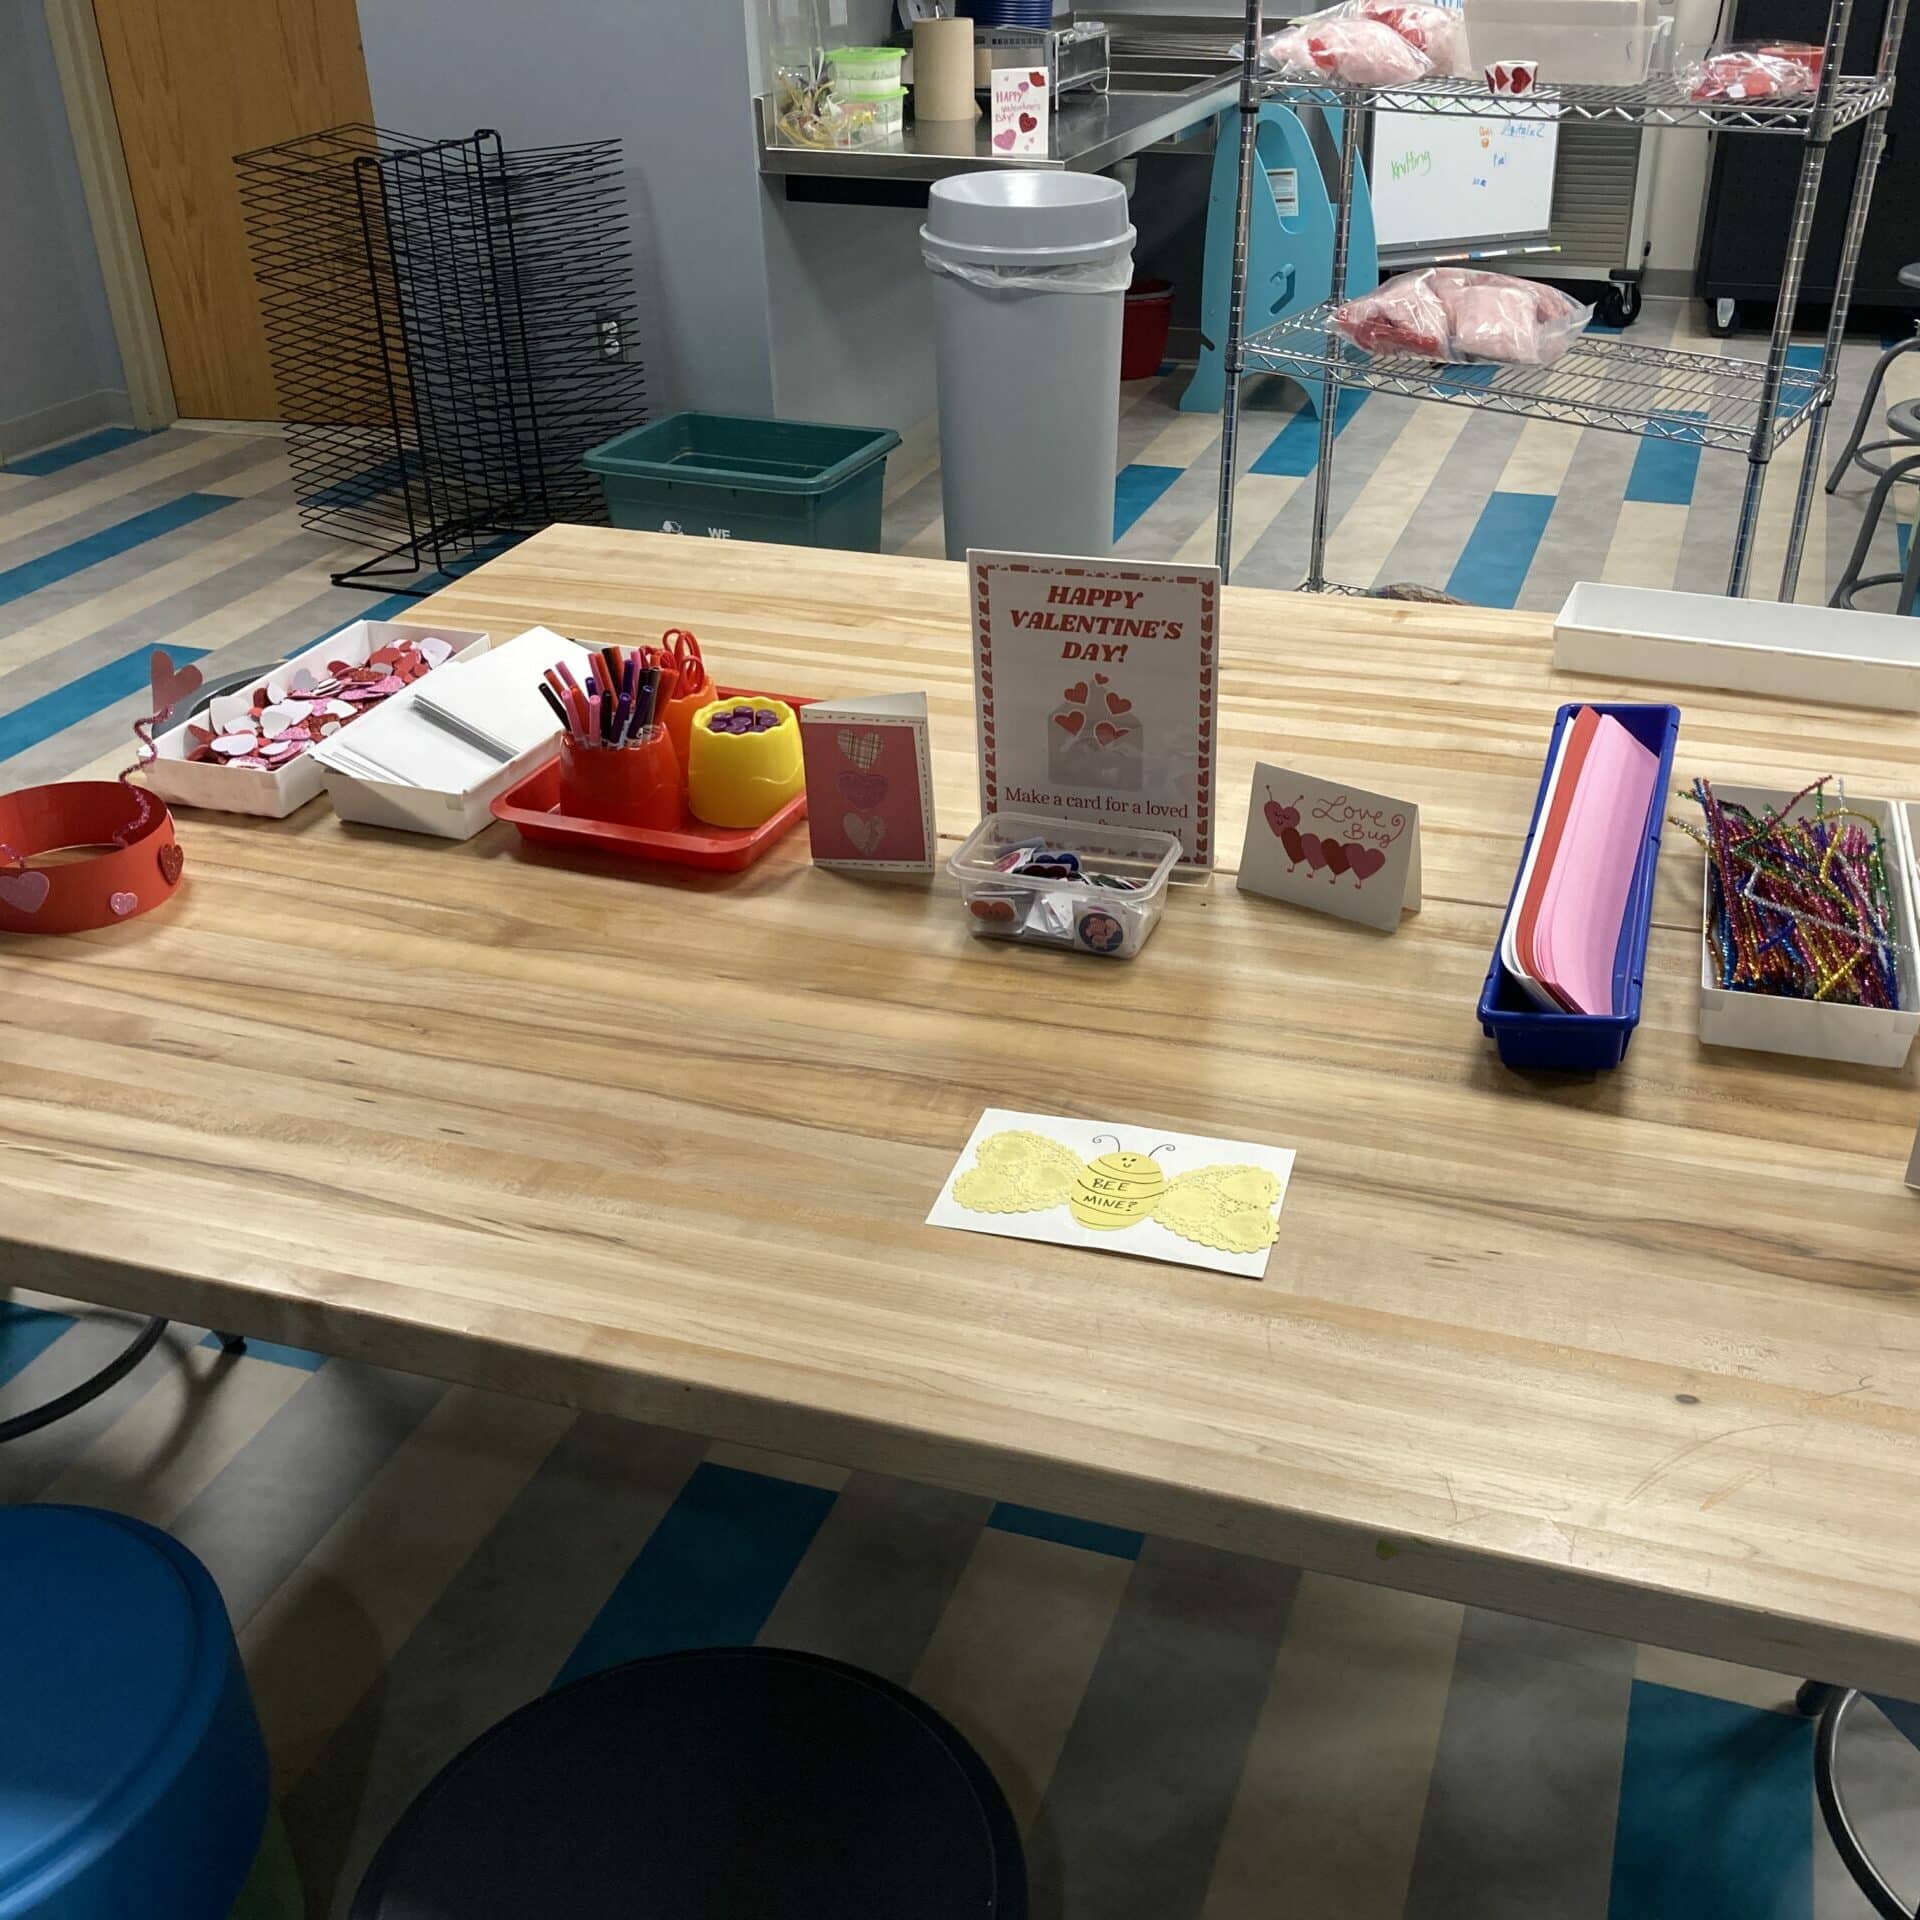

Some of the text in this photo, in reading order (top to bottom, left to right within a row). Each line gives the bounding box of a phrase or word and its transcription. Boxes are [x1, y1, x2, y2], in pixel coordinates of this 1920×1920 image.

[1047, 585, 1143, 609] HAPPY
[1010, 610, 1183, 640] VALENTINE'S
[1062, 641, 1129, 663] DAY!
[1005, 787, 1188, 819] Make a card for a loved
[1312, 795, 1387, 828] Love
[1343, 822, 1394, 849] Bug
[1092, 1177, 1131, 1192] BEE
[1083, 1194, 1139, 1212] MINE?
